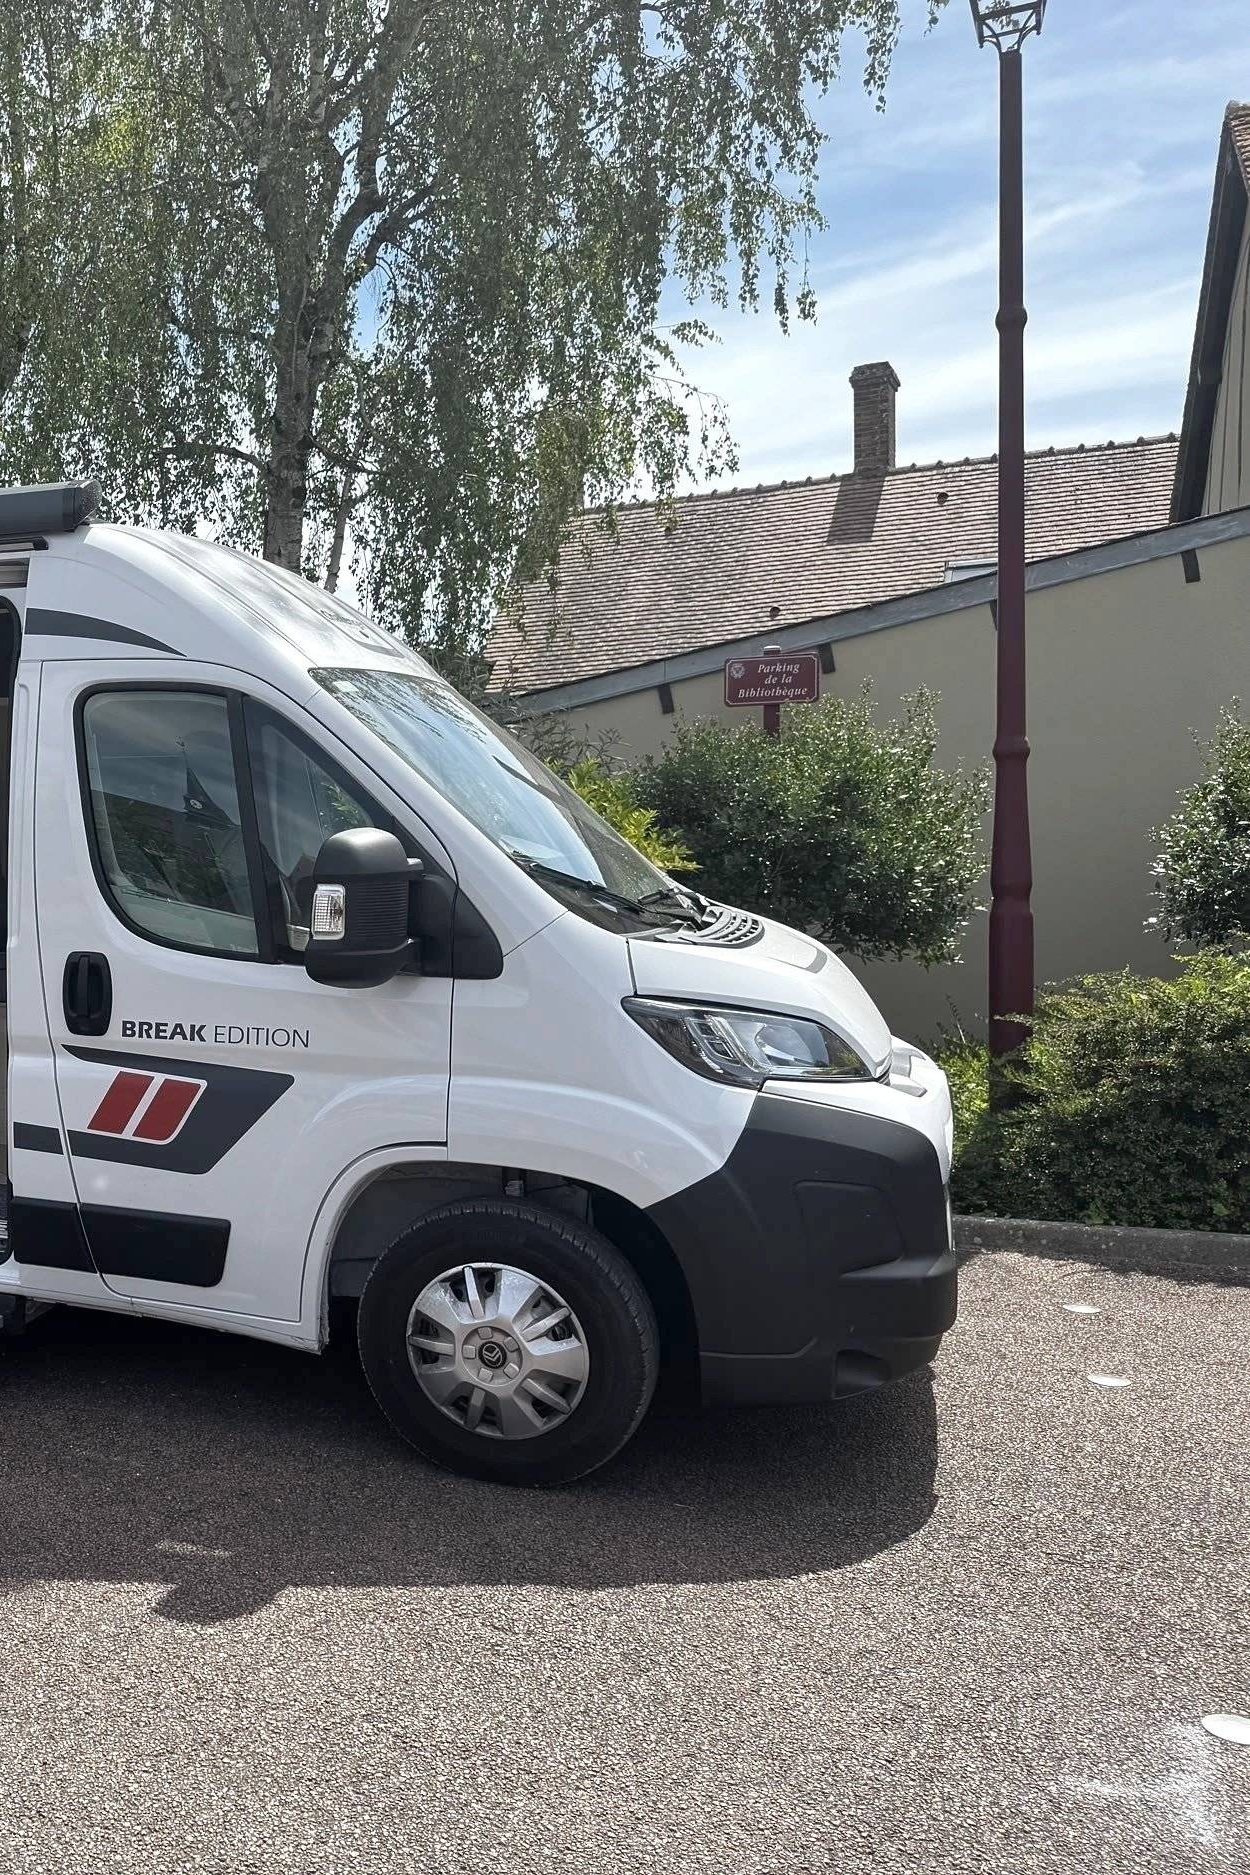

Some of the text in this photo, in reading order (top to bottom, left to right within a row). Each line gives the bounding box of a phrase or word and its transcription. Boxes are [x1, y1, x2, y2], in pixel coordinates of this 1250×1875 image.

[757, 663, 801, 674] Parking
[764, 673, 792, 684] de la
[738, 686, 808, 698] Bibliothèque
[121, 1020, 310, 1048] BREAK EDITION
